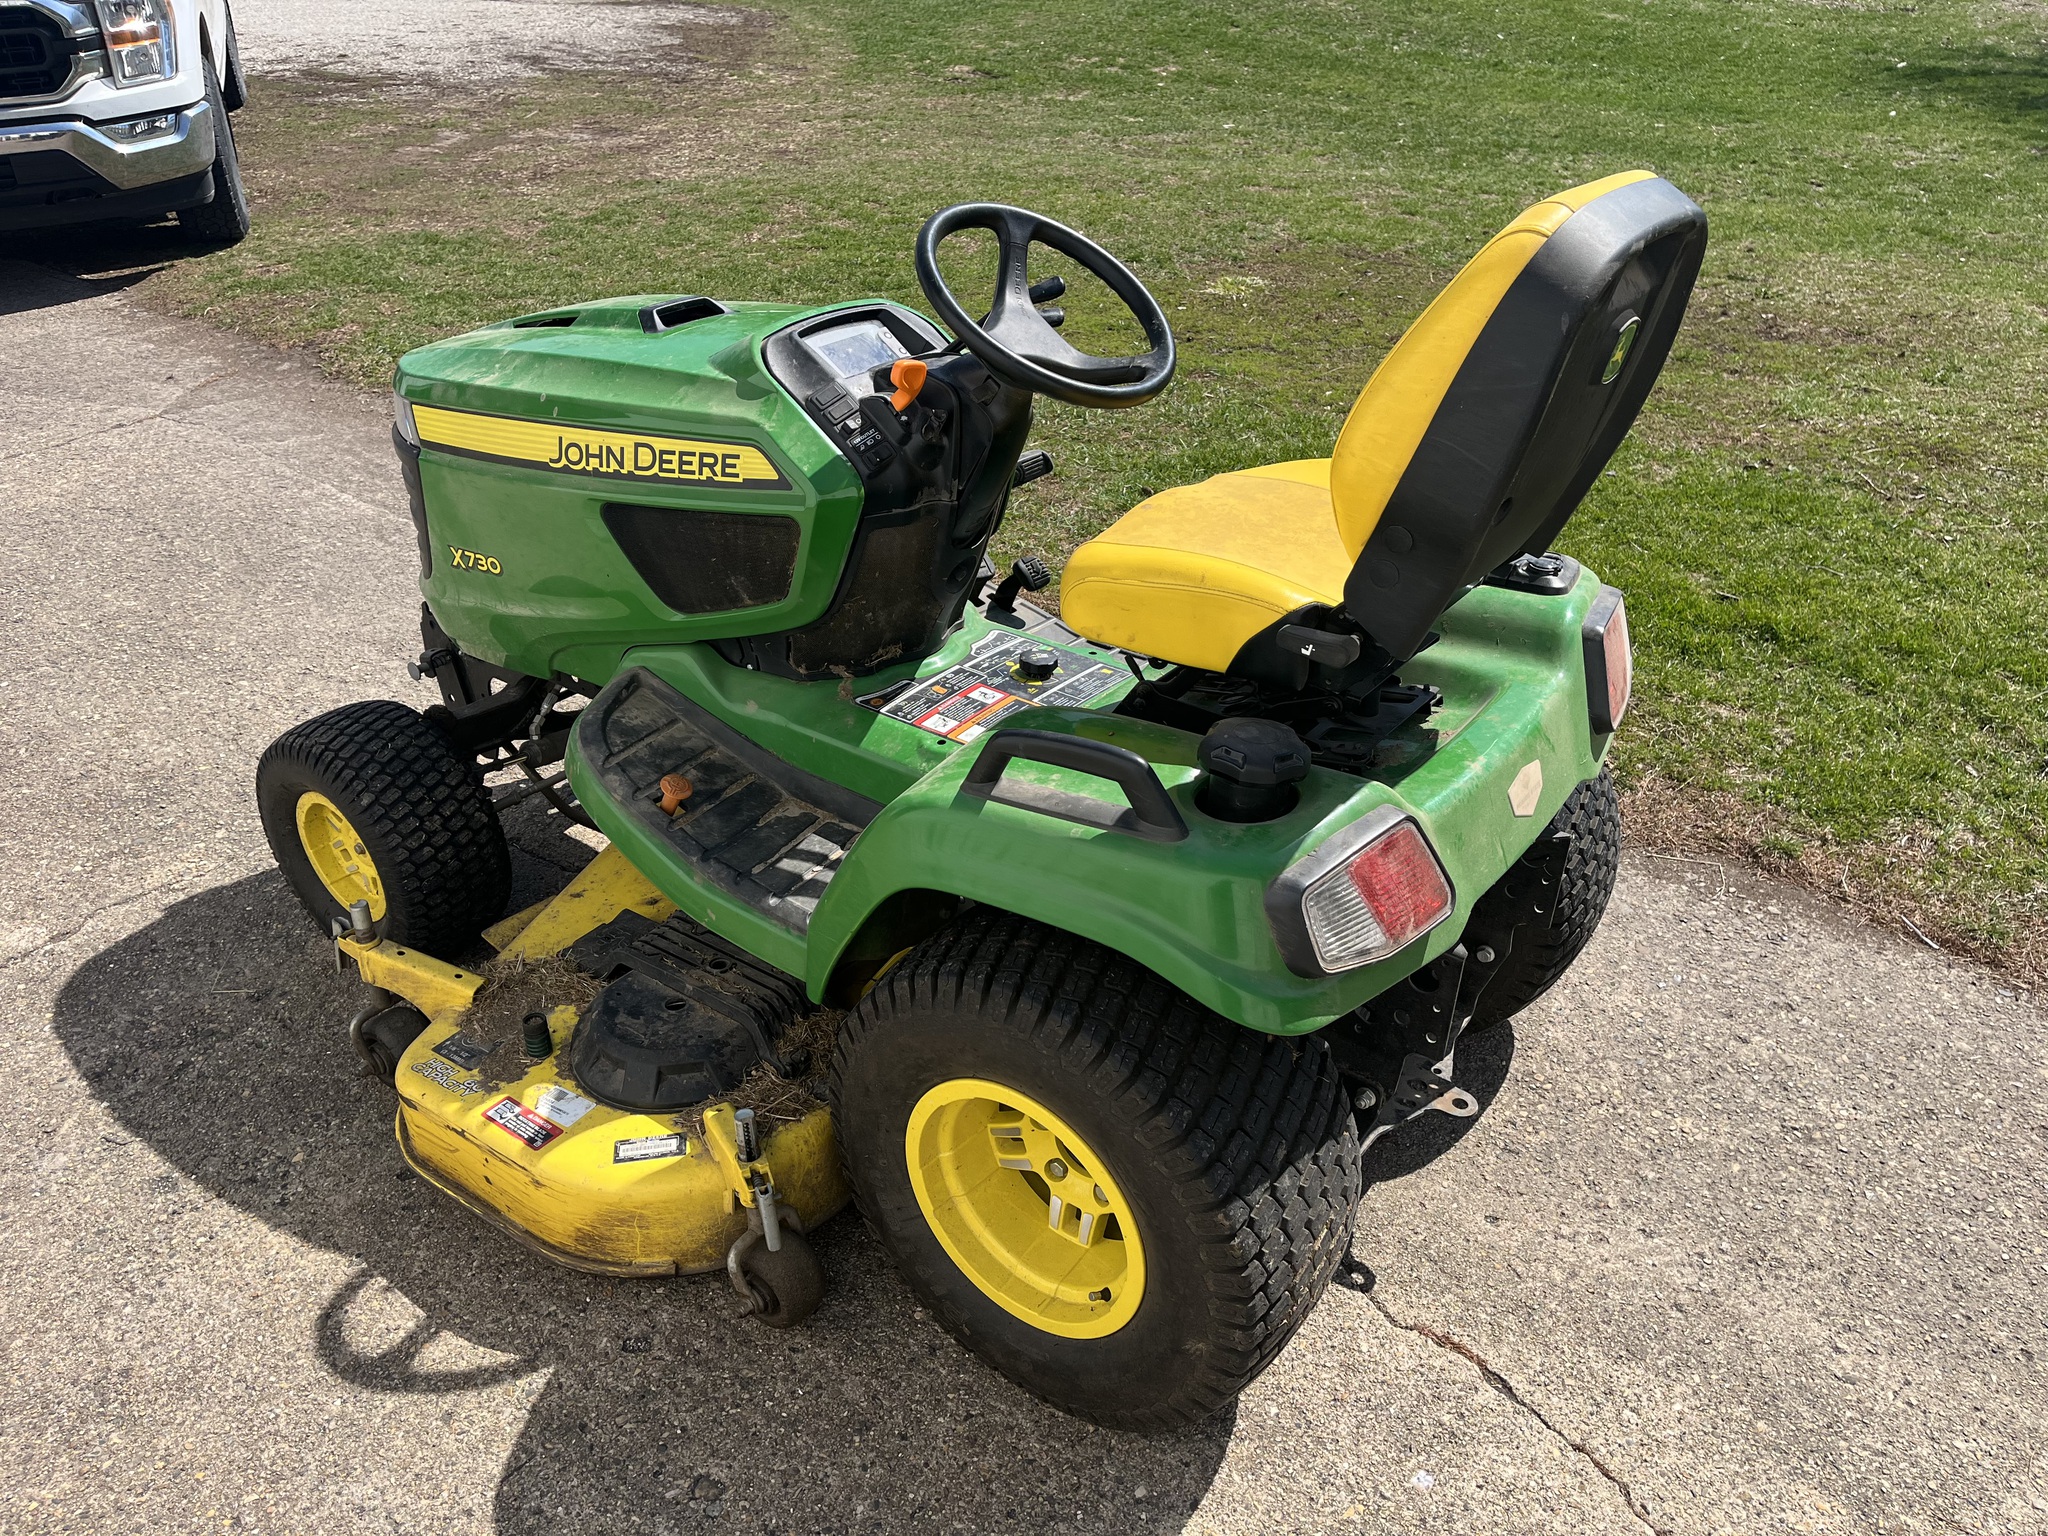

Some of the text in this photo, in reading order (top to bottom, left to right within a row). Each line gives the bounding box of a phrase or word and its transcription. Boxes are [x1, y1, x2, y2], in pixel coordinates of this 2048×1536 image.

[860, 427, 875, 440] OUTLET
[549, 436, 742, 479] JOHN DEERE
[448, 545, 503, 576] X730
[411, 1063, 476, 1097] CAPACITY
[425, 1058, 460, 1078] HIGH
[531, 1116, 552, 1129] DANGER
